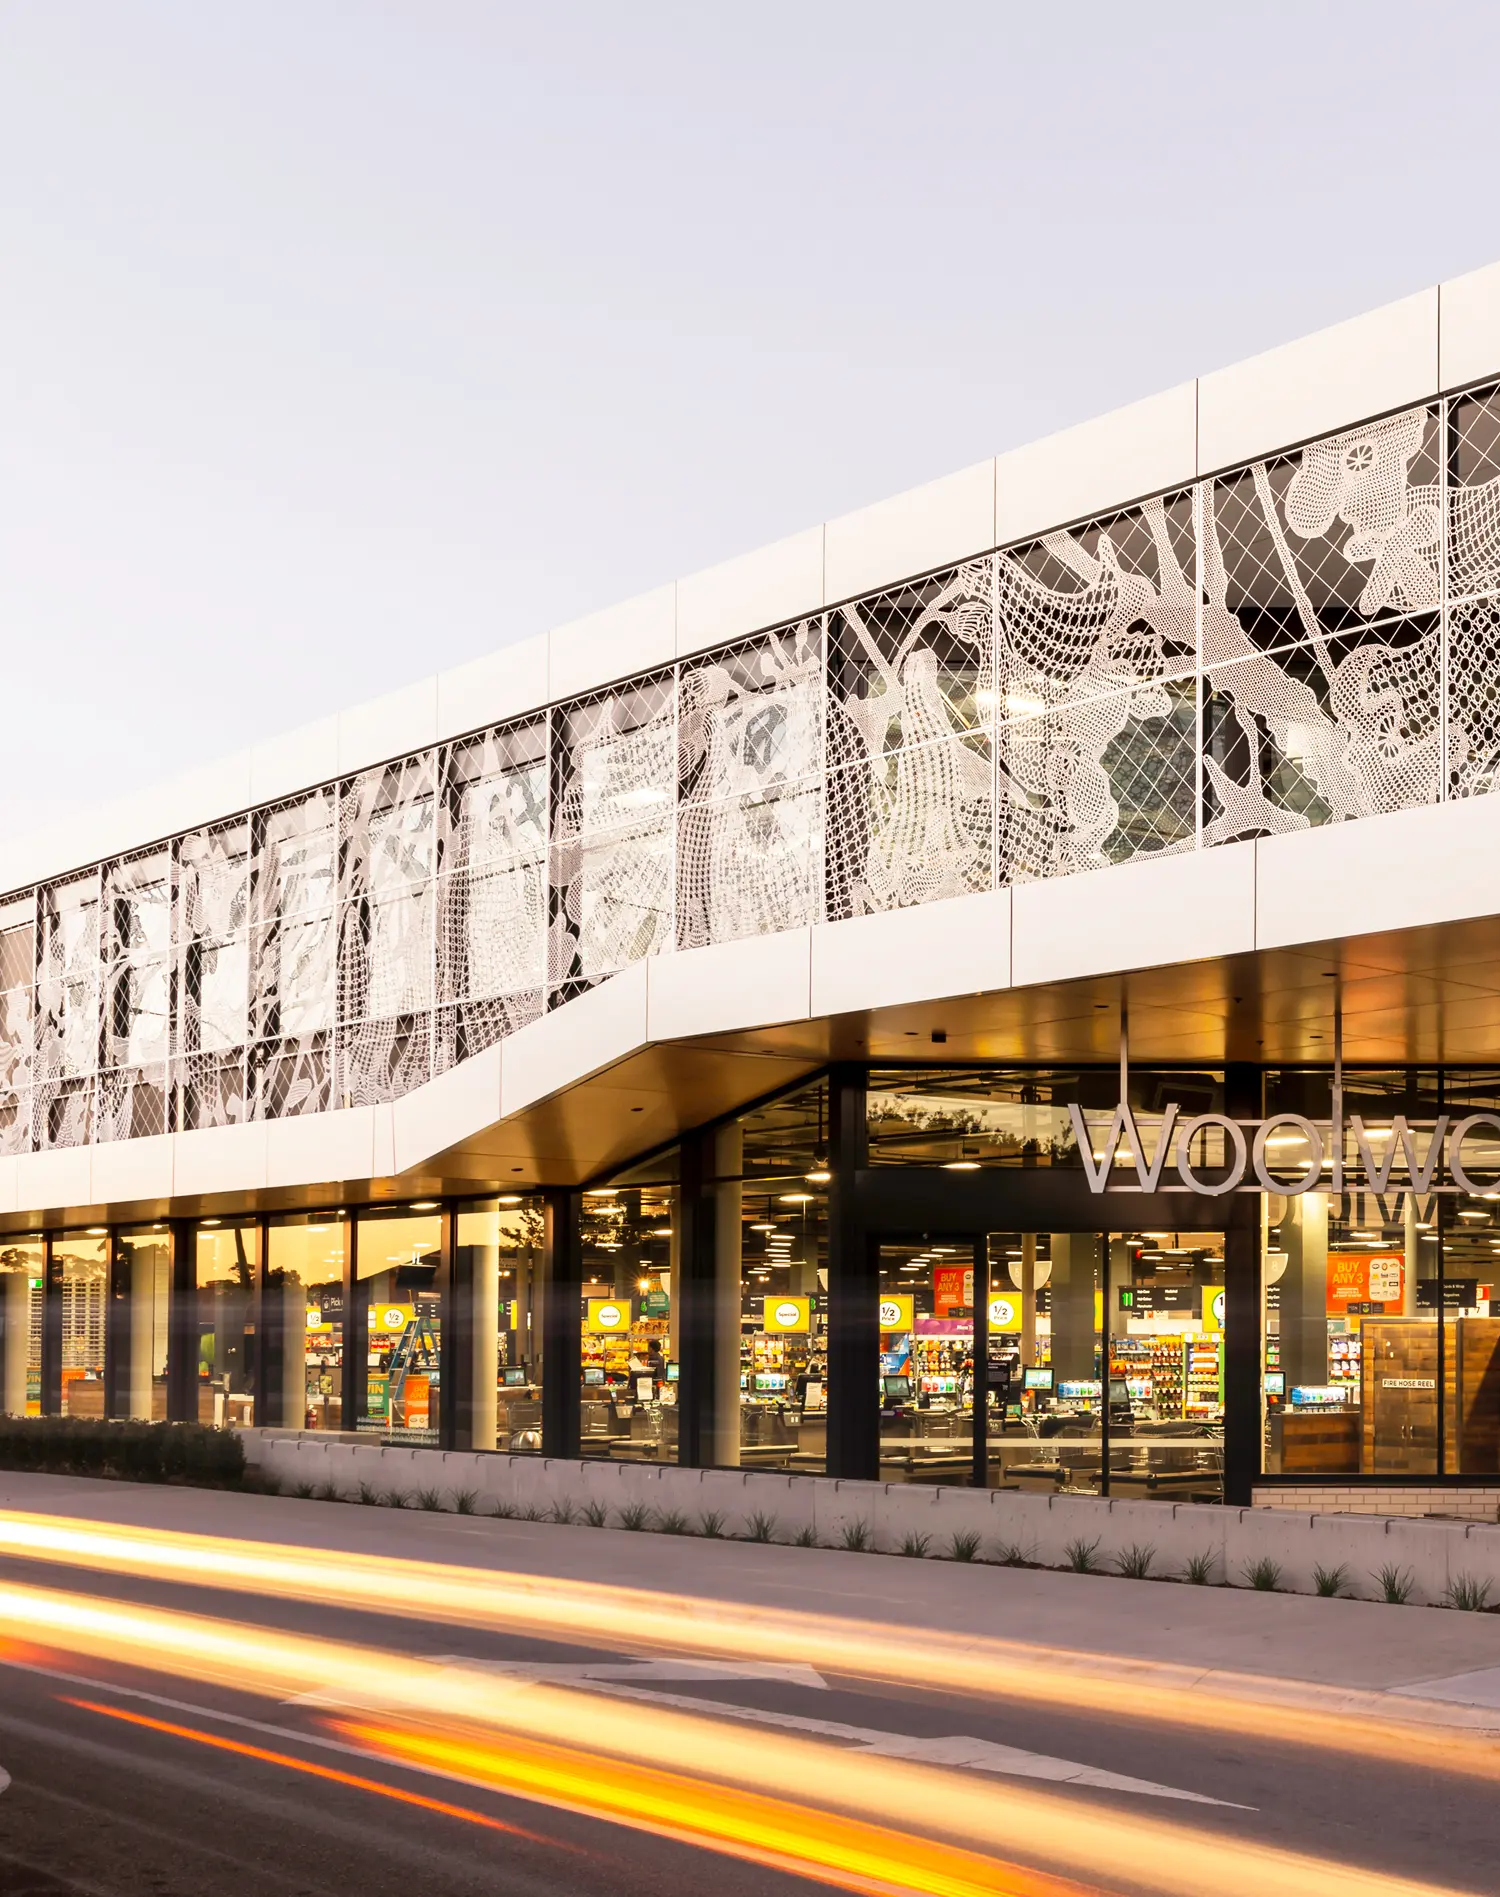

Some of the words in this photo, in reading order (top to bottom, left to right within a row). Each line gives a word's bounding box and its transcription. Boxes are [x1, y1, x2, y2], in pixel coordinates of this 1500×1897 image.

[1337, 1261, 1360, 1272] BUY
[940, 1273, 956, 1282] BUY
[1332, 1274, 1356, 1284] ANY
[1357, 1273, 1364, 1284] 3
[937, 1283, 953, 1292] ANY
[954, 1282, 960, 1292] 3
[1122, 1292, 1133, 1307] 11
[882, 1306, 895, 1317] 1/2
[994, 1305, 1008, 1316] 1/2
[310, 1314, 320, 1322] 1/2
[389, 1312, 400, 1321] 1/2
